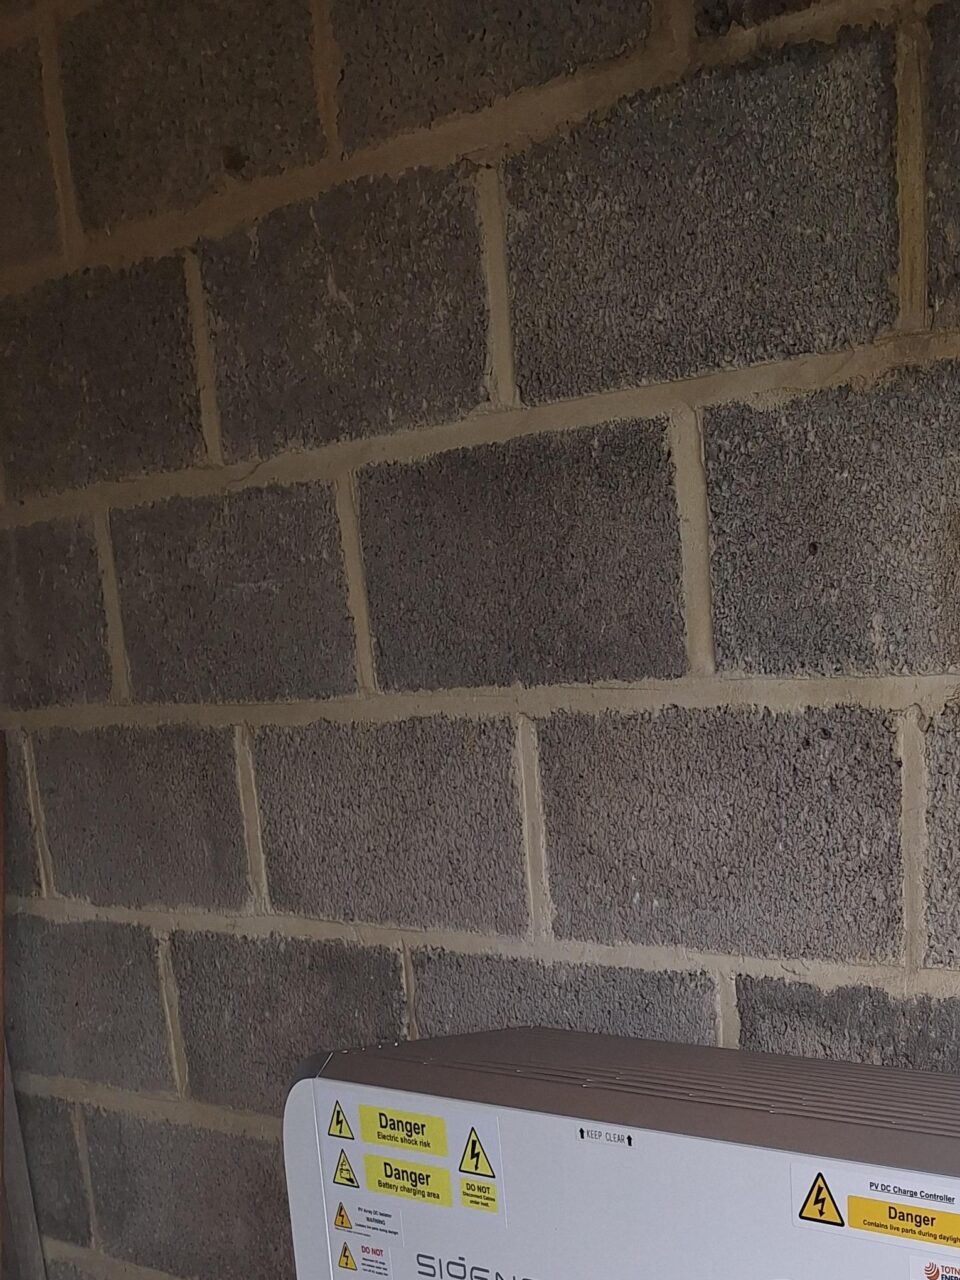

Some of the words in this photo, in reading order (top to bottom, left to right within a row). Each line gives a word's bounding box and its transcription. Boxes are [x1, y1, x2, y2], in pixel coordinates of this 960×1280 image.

[378, 1112, 427, 1138] Danger
[377, 1131, 399, 1142] Electric
[400, 1137, 418, 1146] shock
[420, 1140, 431, 1148] risk
[586, 1129, 603, 1139] KEEP
[605, 1132, 626, 1144] CLEAR
[383, 1162, 431, 1188] Danger
[377, 1180, 398, 1192] Battery
[400, 1185, 426, 1198] charging
[426, 1192, 440, 1200] area
[466, 1182, 476, 1192] DO
[477, 1184, 491, 1194] NOT
[869, 1182, 879, 1190] PV
[881, 1184, 891, 1193] DC
[893, 1186, 918, 1198] Charge
[919, 1191, 956, 1204] Controller
[888, 1206, 937, 1227] Danger
[862, 1219, 888, 1230] Contains
[890, 1223, 900, 1232] live
[901, 1226, 917, 1236] parts
[917, 1229, 938, 1240] during
[361, 1245, 370, 1255] DO
[371, 1247, 384, 1257] NOT
